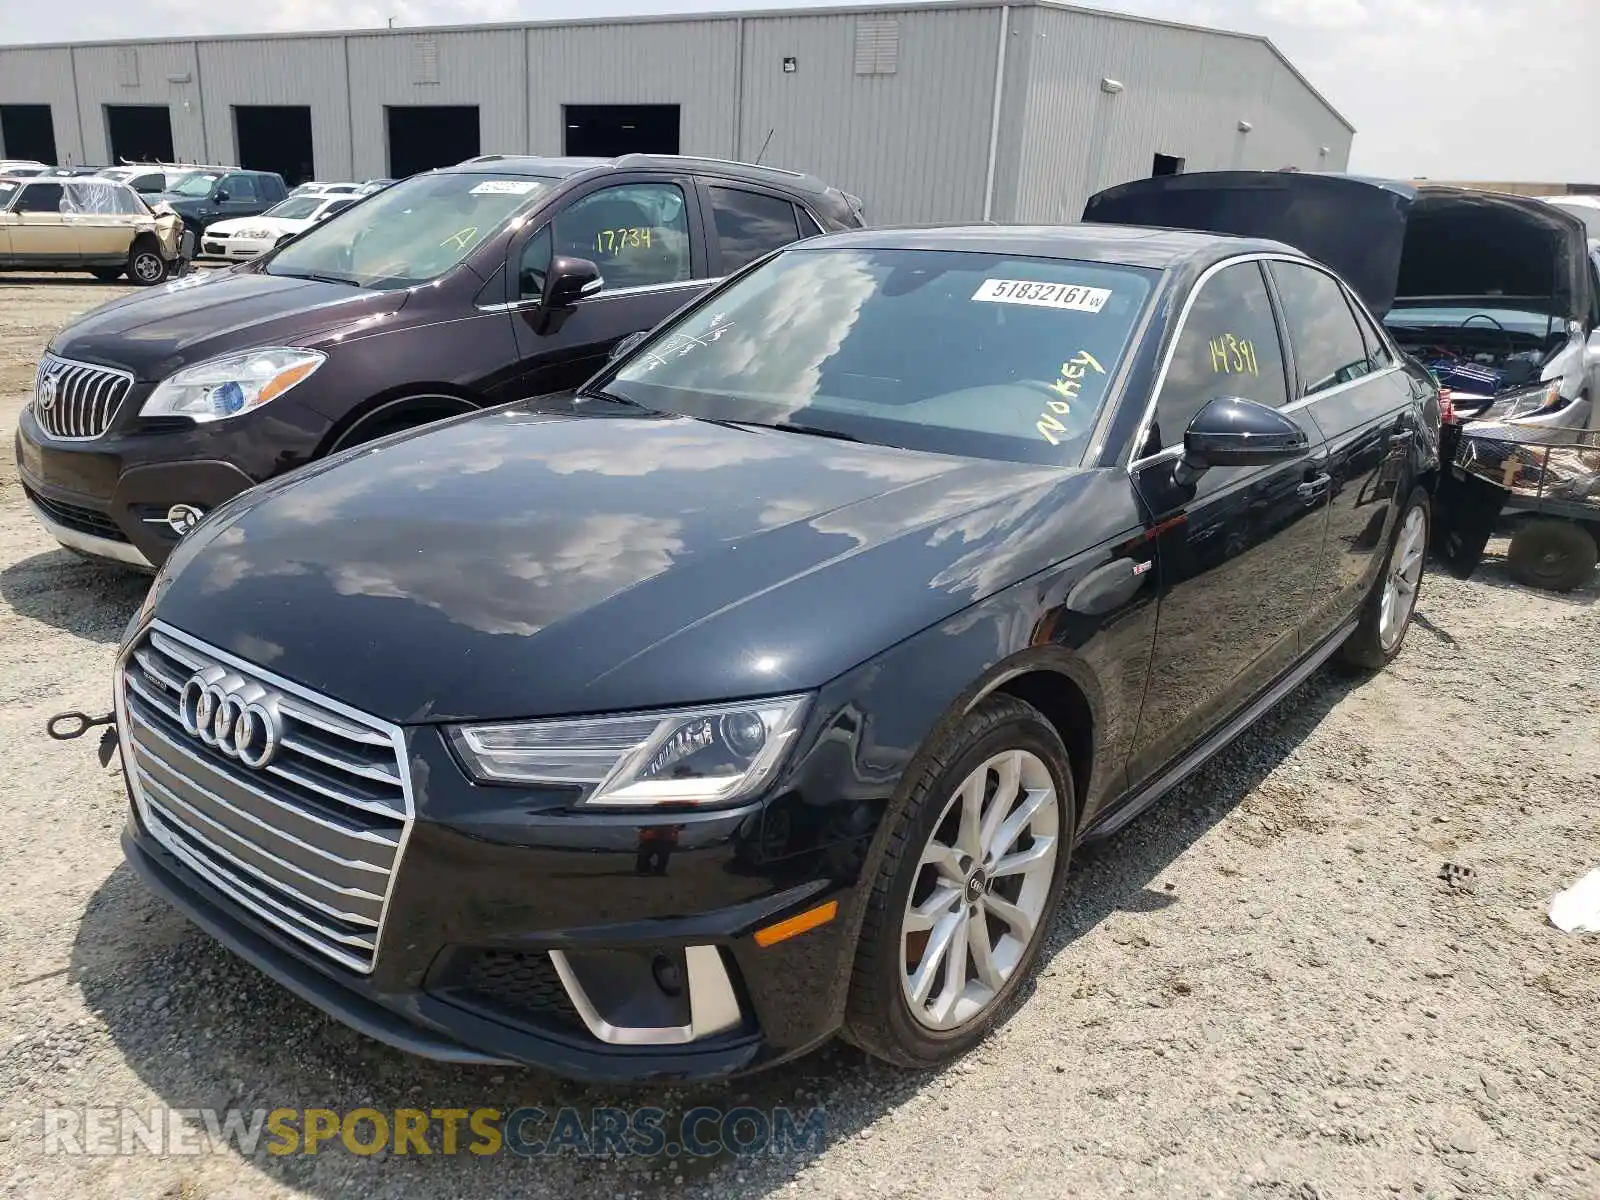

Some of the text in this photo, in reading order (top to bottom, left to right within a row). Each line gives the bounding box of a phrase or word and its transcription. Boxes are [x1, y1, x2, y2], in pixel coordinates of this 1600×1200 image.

[597, 227, 651, 256] 17,734
[992, 281, 1090, 304] 51832161
[1209, 333, 1258, 377] 14391
